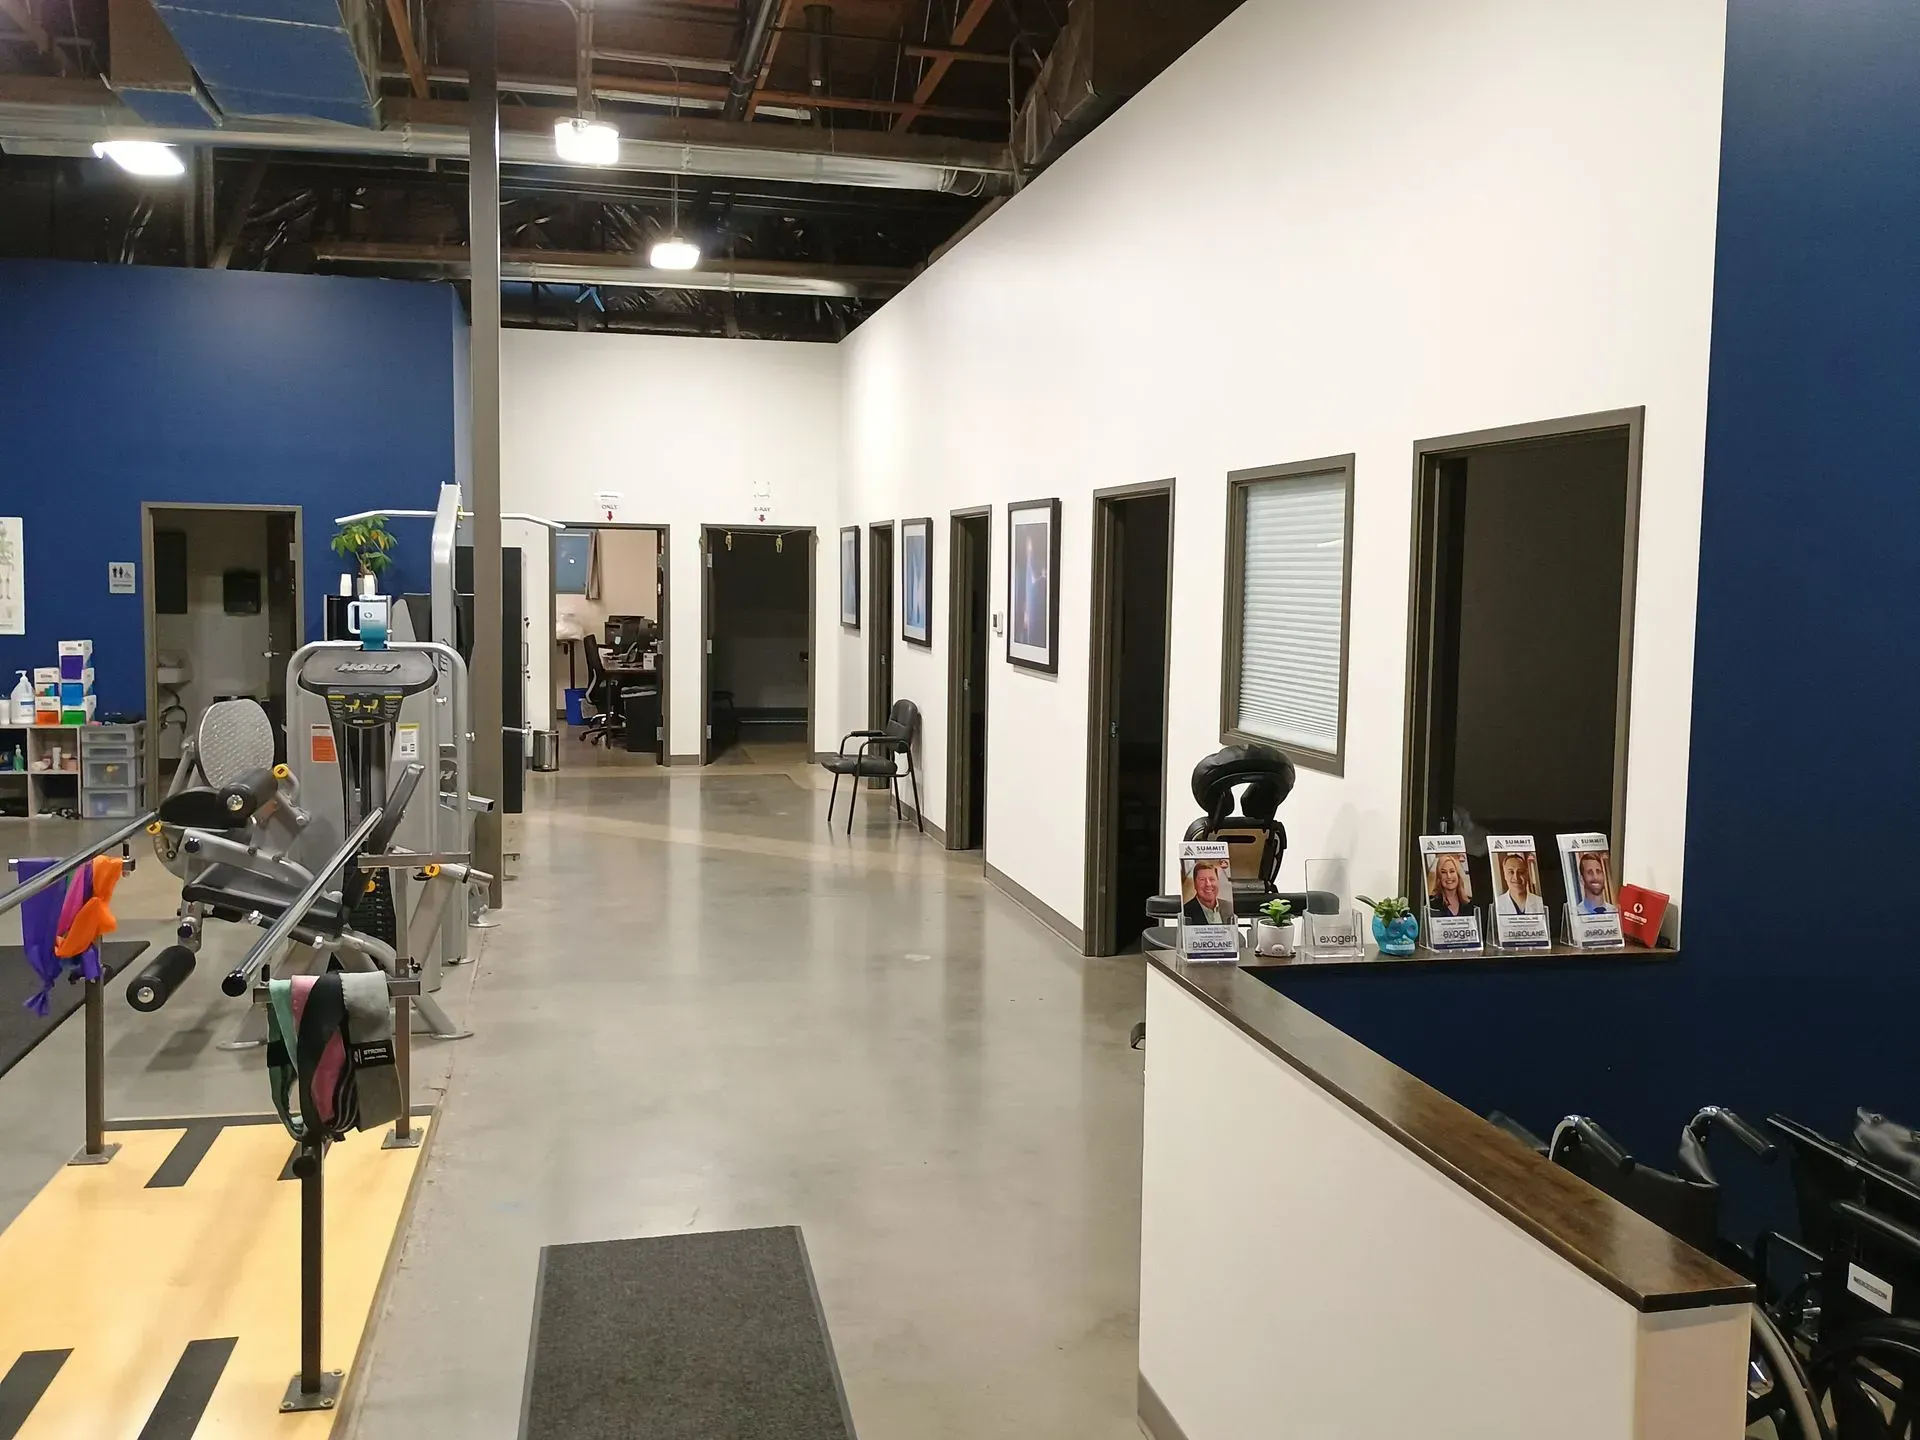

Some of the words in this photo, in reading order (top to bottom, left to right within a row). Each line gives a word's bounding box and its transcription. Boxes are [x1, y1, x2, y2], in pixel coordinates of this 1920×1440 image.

[337, 663, 400, 674] HOIST
[1443, 929, 1477, 939] exogen
[1192, 940, 1232, 949] DUROLANE
[1320, 934, 1357, 945] exogen
